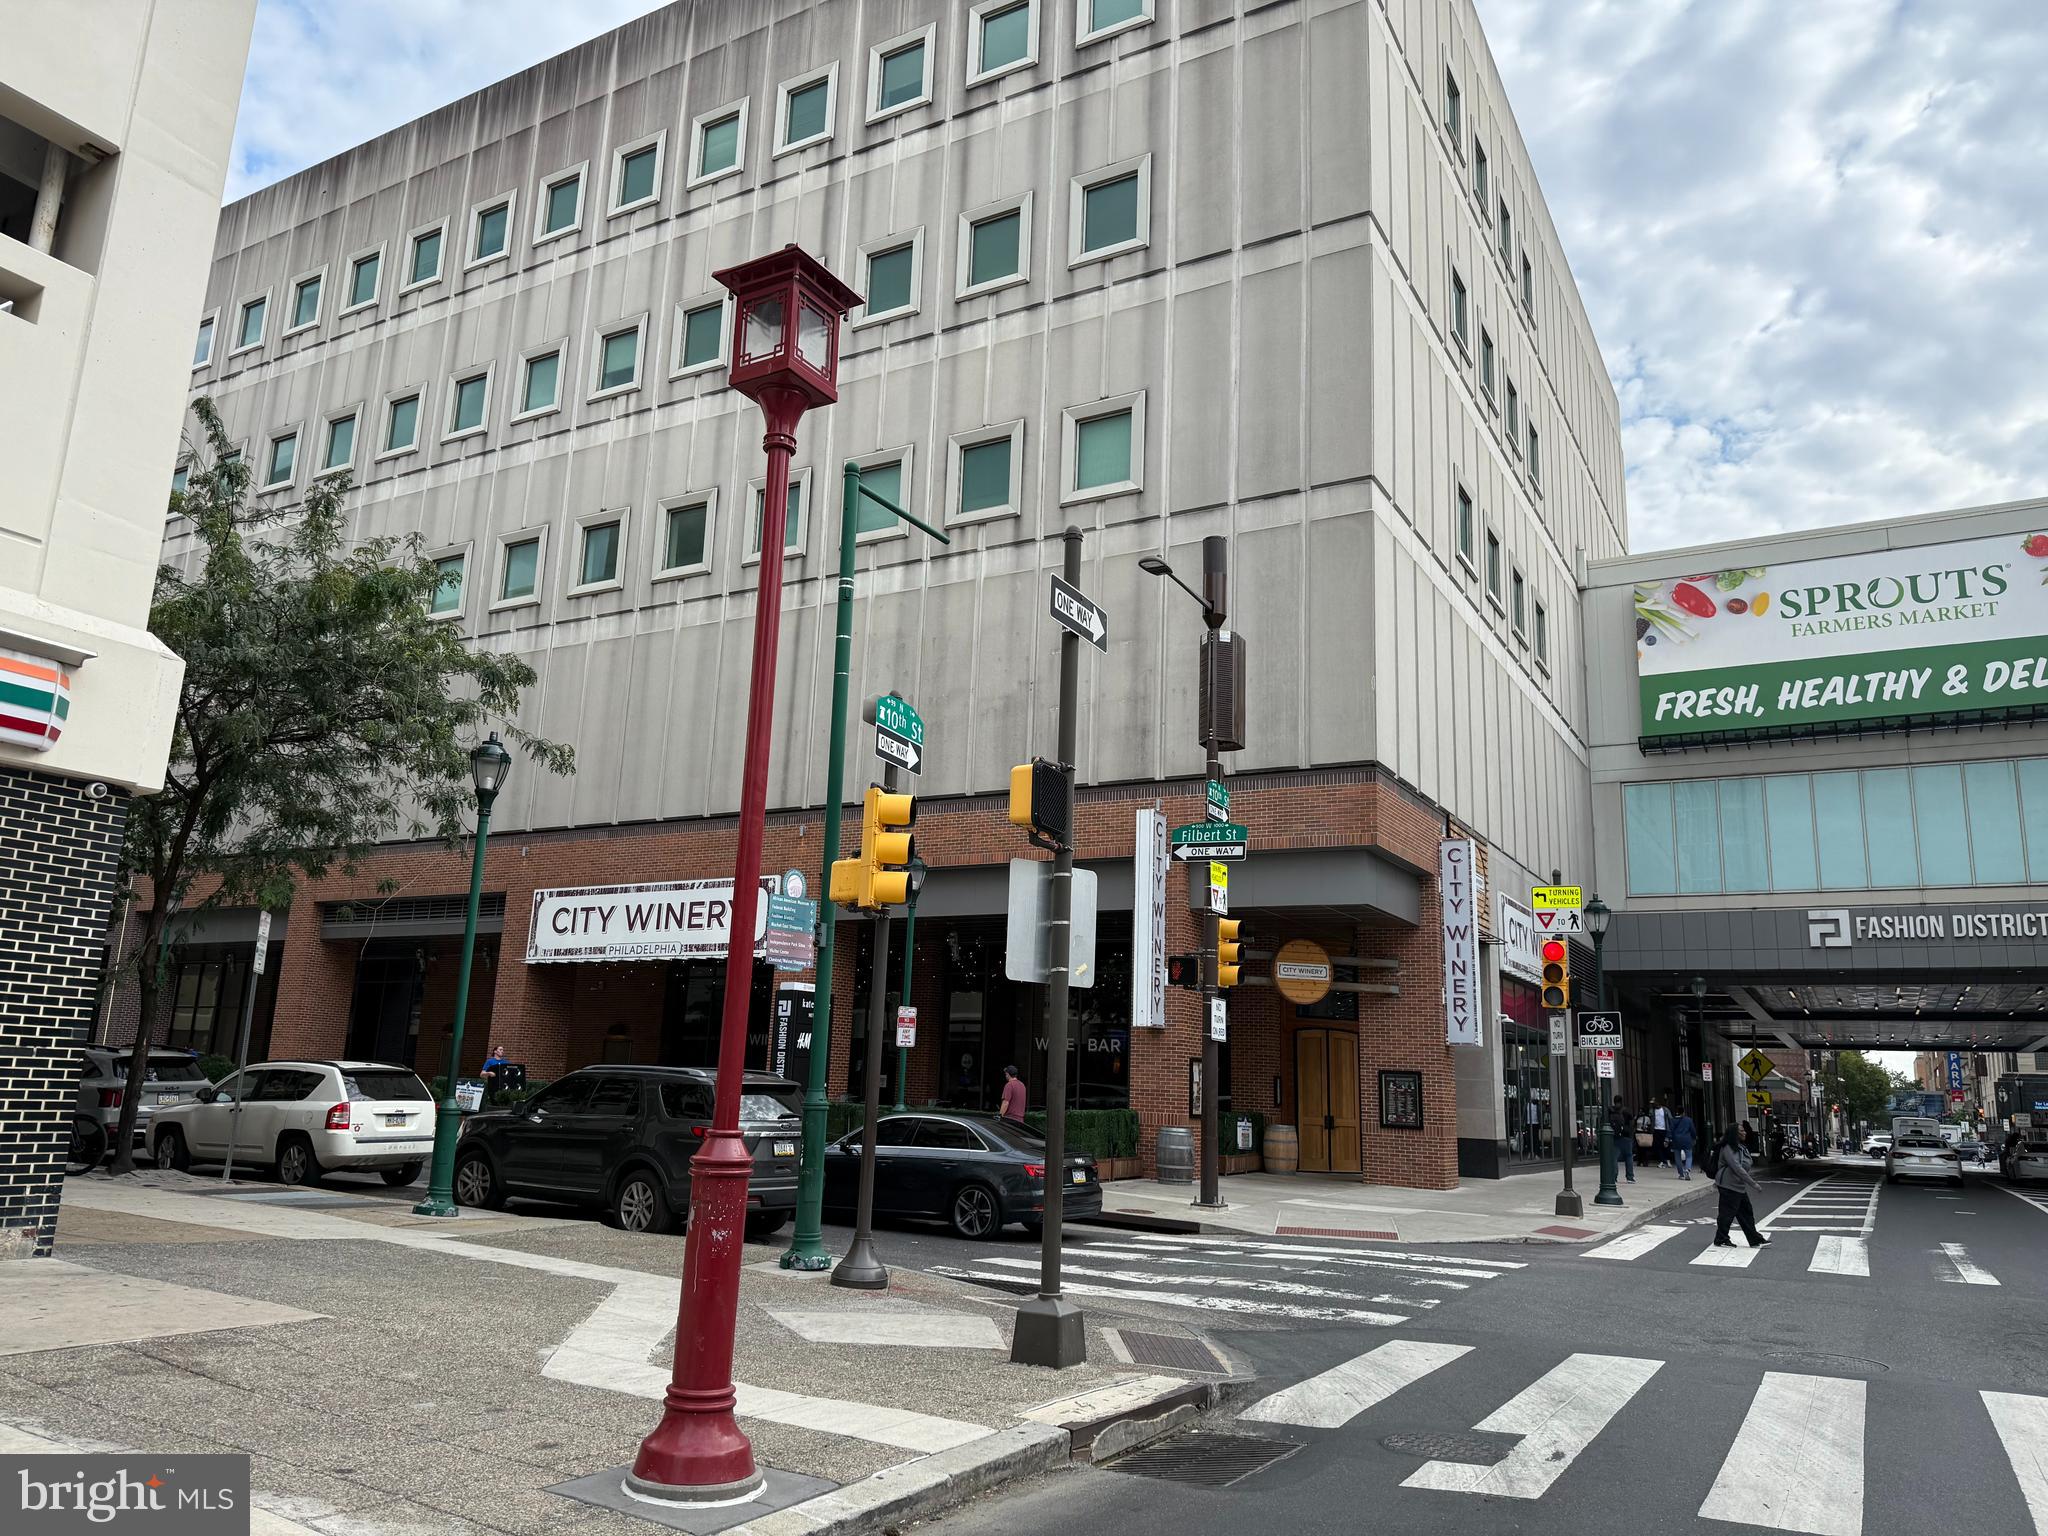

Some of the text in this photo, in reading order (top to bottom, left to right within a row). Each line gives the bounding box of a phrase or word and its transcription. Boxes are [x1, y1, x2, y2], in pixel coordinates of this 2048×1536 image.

[1779, 564, 2008, 619] SPROUTS
[1057, 592, 1093, 629] ONE WAY
[1791, 601, 1999, 638] FARMERS MARKET
[1655, 656, 2048, 721] FRESH, HEALTHY & DEL
[887, 708, 922, 743] 10th St
[881, 736, 909, 760] ONE WAY
[1182, 829, 1237, 841] Filbert St
[1191, 847, 1235, 856] ONE WAY
[552, 899, 734, 935] CITY WINER
[1154, 821, 1164, 1014] CITY WINERY
[1558, 918, 1566, 926] TO
[1856, 913, 2048, 939] FASHION DISTRICT
[609, 944, 677, 956] PHILADELPHIA
[1446, 848, 1469, 1032] CITY WINERY
[1509, 917, 1527, 951] CITY
[802, 999, 814, 1008] kate
[778, 1018, 788, 1049] FASHION
[1088, 1038, 1121, 1053] BAR
[1581, 1036, 1620, 1046] BIKE LANE
[1950, 1053, 1960, 1088] PARK
